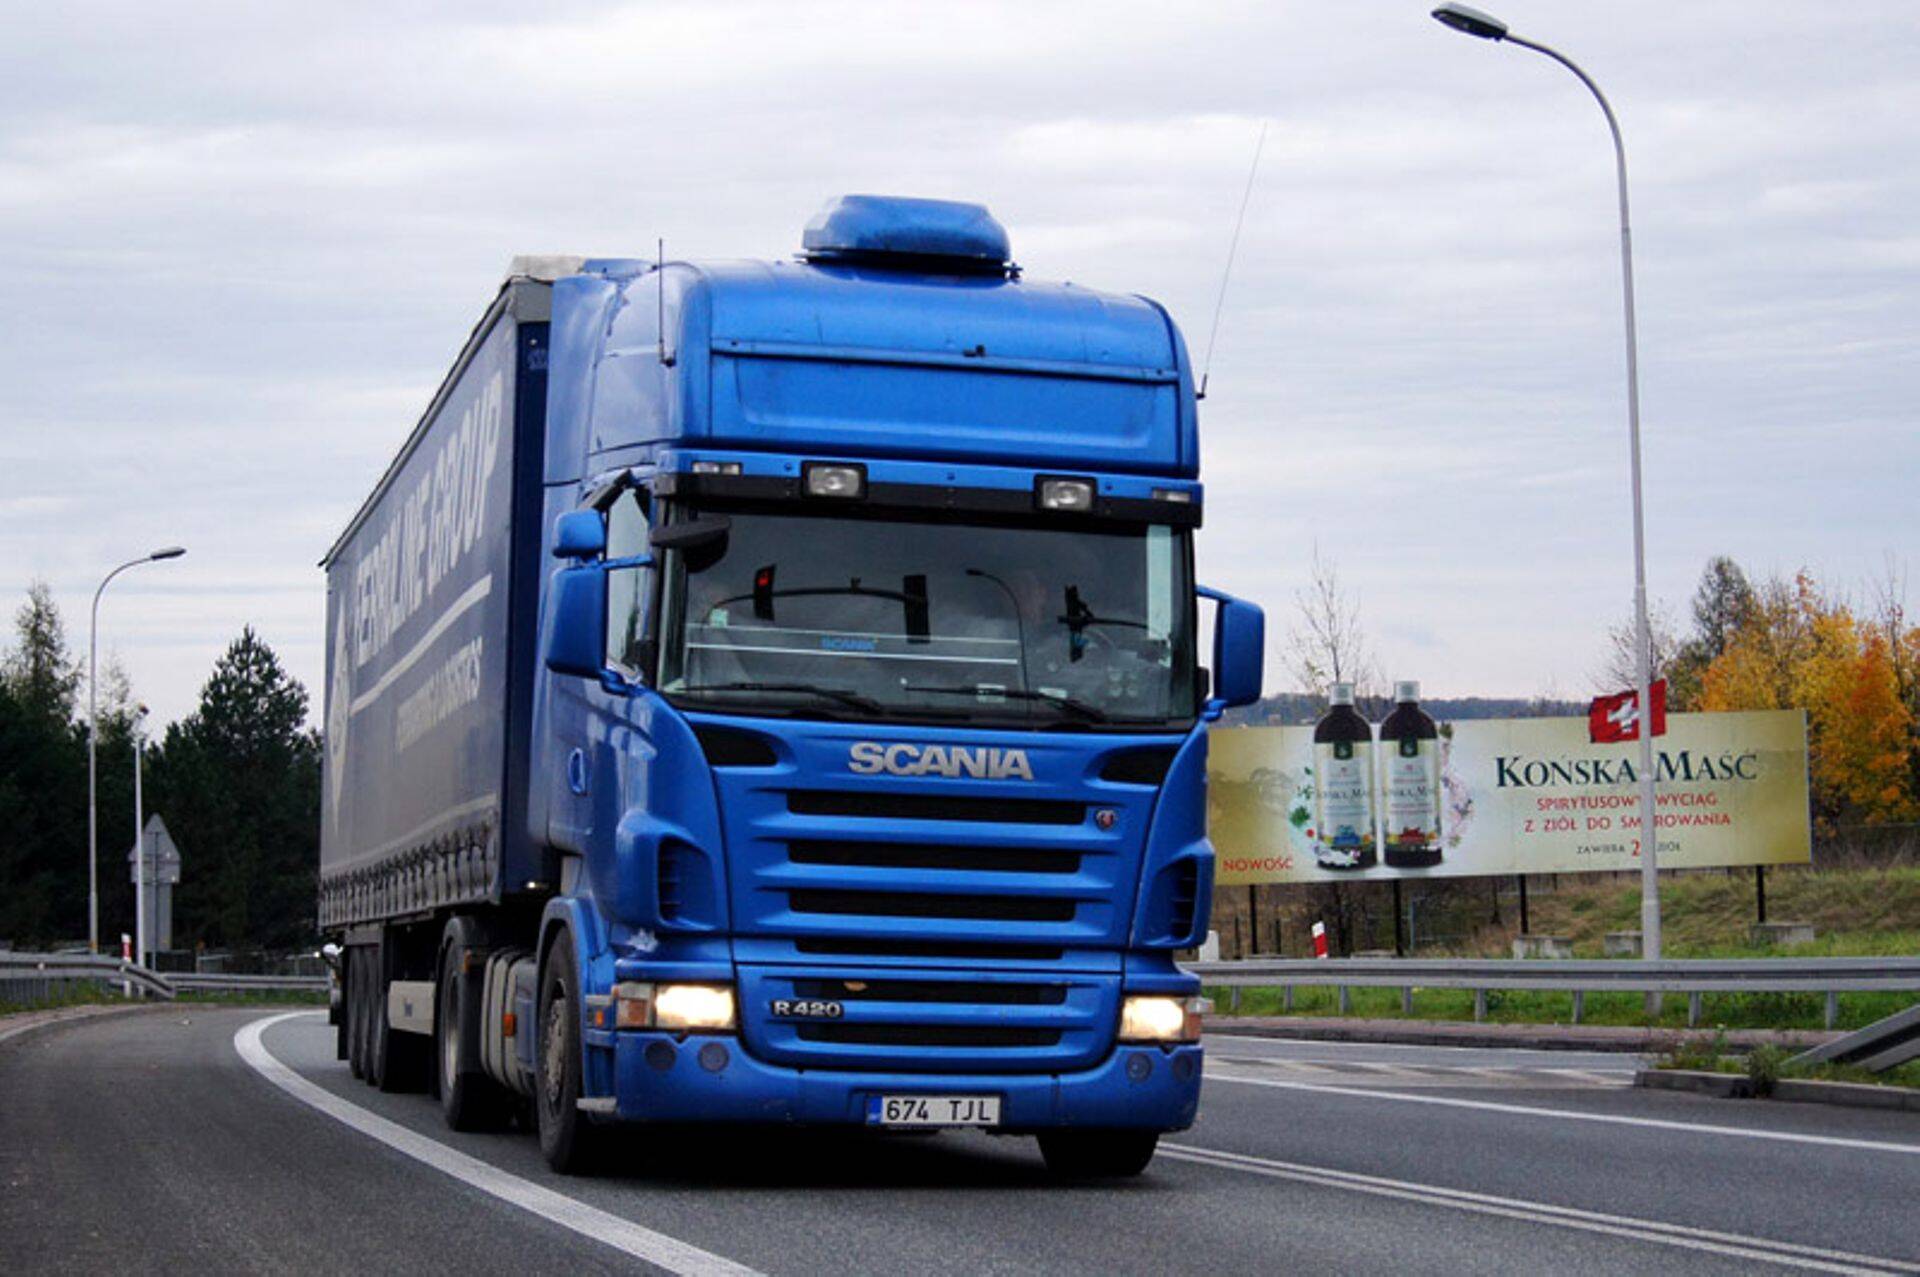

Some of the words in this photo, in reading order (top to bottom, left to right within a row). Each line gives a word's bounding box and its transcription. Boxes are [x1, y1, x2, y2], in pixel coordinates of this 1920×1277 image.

[428, 369, 502, 595] GROUP
[848, 741, 1034, 780] SCANIA
[1496, 754, 1638, 788] KOŃSKA
[1654, 749, 1758, 783] MAŚĆ
[1524, 820, 1535, 833] Z
[1587, 817, 1611, 830] DO
[1621, 813, 1731, 829] SMROWANIA
[1223, 855, 1293, 871] NOWOŚĆ
[886, 1100, 929, 1121] 674
[949, 1100, 991, 1121] TJL
